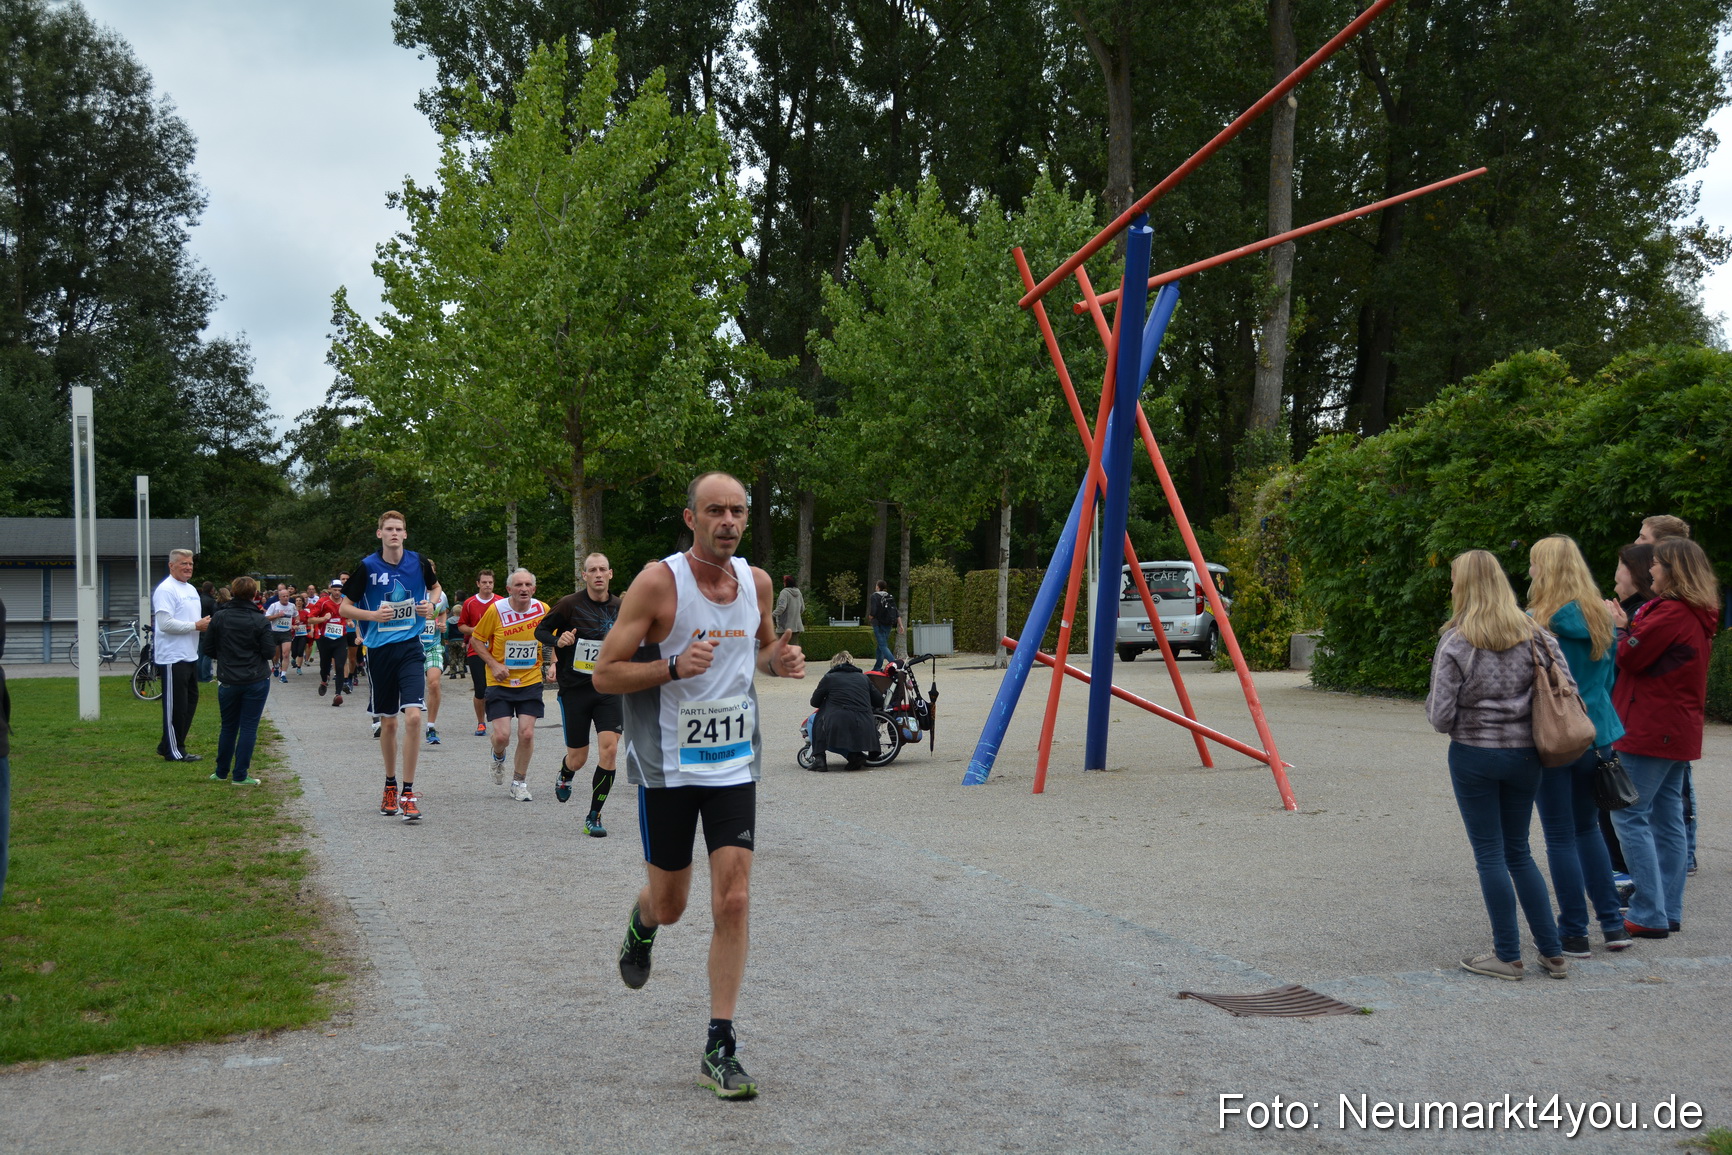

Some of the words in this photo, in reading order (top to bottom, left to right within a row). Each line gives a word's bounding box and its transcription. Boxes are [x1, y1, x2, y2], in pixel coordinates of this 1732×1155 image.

[370, 572, 389, 585] 14
[392, 606, 412, 619] 030
[504, 626, 524, 636] MAX
[709, 629, 748, 638] KLEBL
[508, 647, 535, 658] 2737
[585, 648, 599, 661] 12
[681, 708, 706, 716] PARTL
[709, 704, 740, 714] Neumarkt
[687, 713, 744, 744] 2411
[699, 749, 736, 761] Thomas
